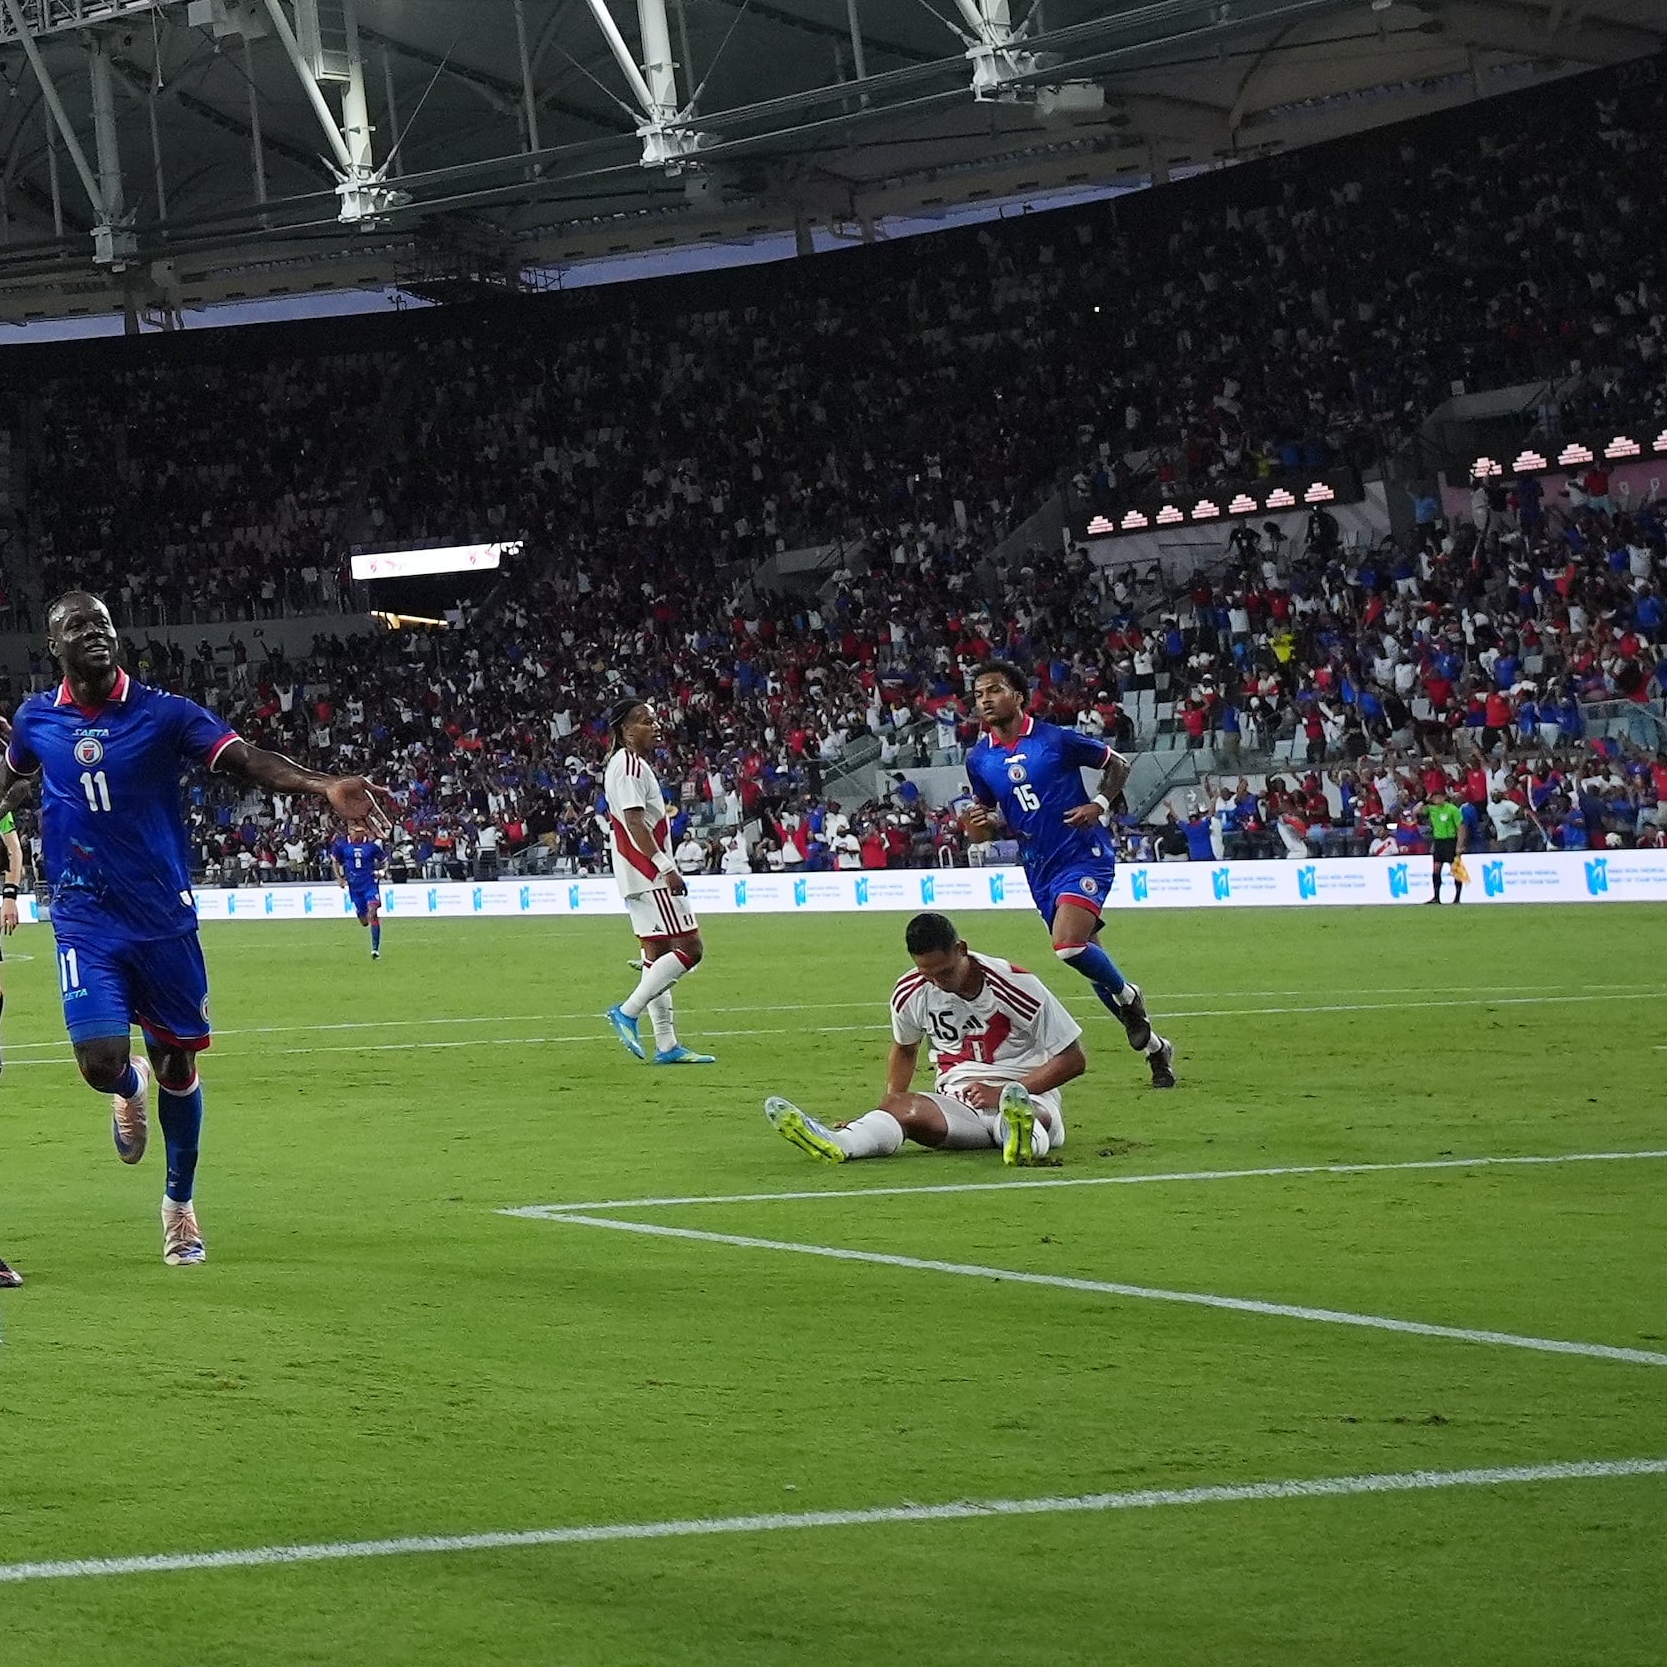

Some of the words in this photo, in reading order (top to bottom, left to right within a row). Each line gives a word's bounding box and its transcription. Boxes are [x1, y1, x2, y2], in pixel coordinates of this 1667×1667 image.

[78, 770, 113, 813] 11
[1012, 783, 1041, 813] 15
[59, 947, 81, 993] 11
[928, 1010, 960, 1042] 15
